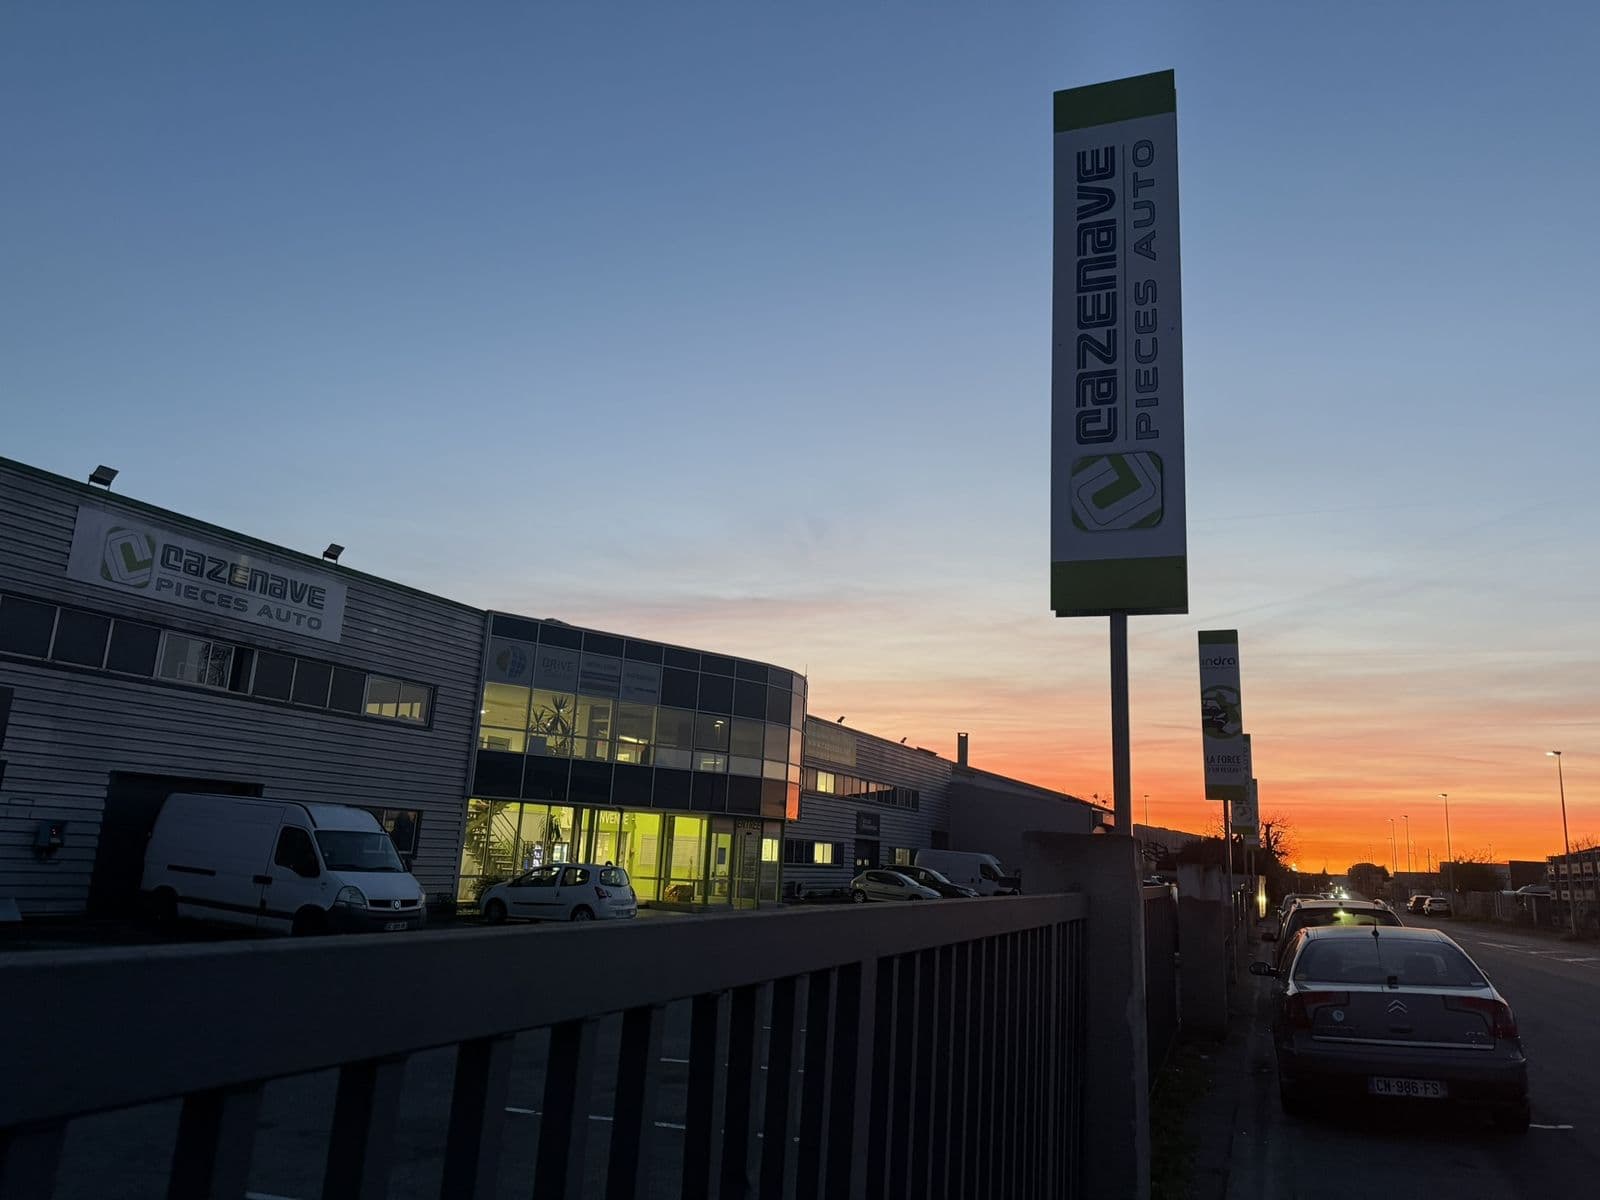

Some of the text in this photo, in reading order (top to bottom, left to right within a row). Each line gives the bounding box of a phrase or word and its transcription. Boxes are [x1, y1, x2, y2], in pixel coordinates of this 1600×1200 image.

[1132, 139, 1160, 441] PIECES AUTO
[155, 577, 323, 632] PIECES AUTO
[1207, 754, 1241, 764] LA FORCE
